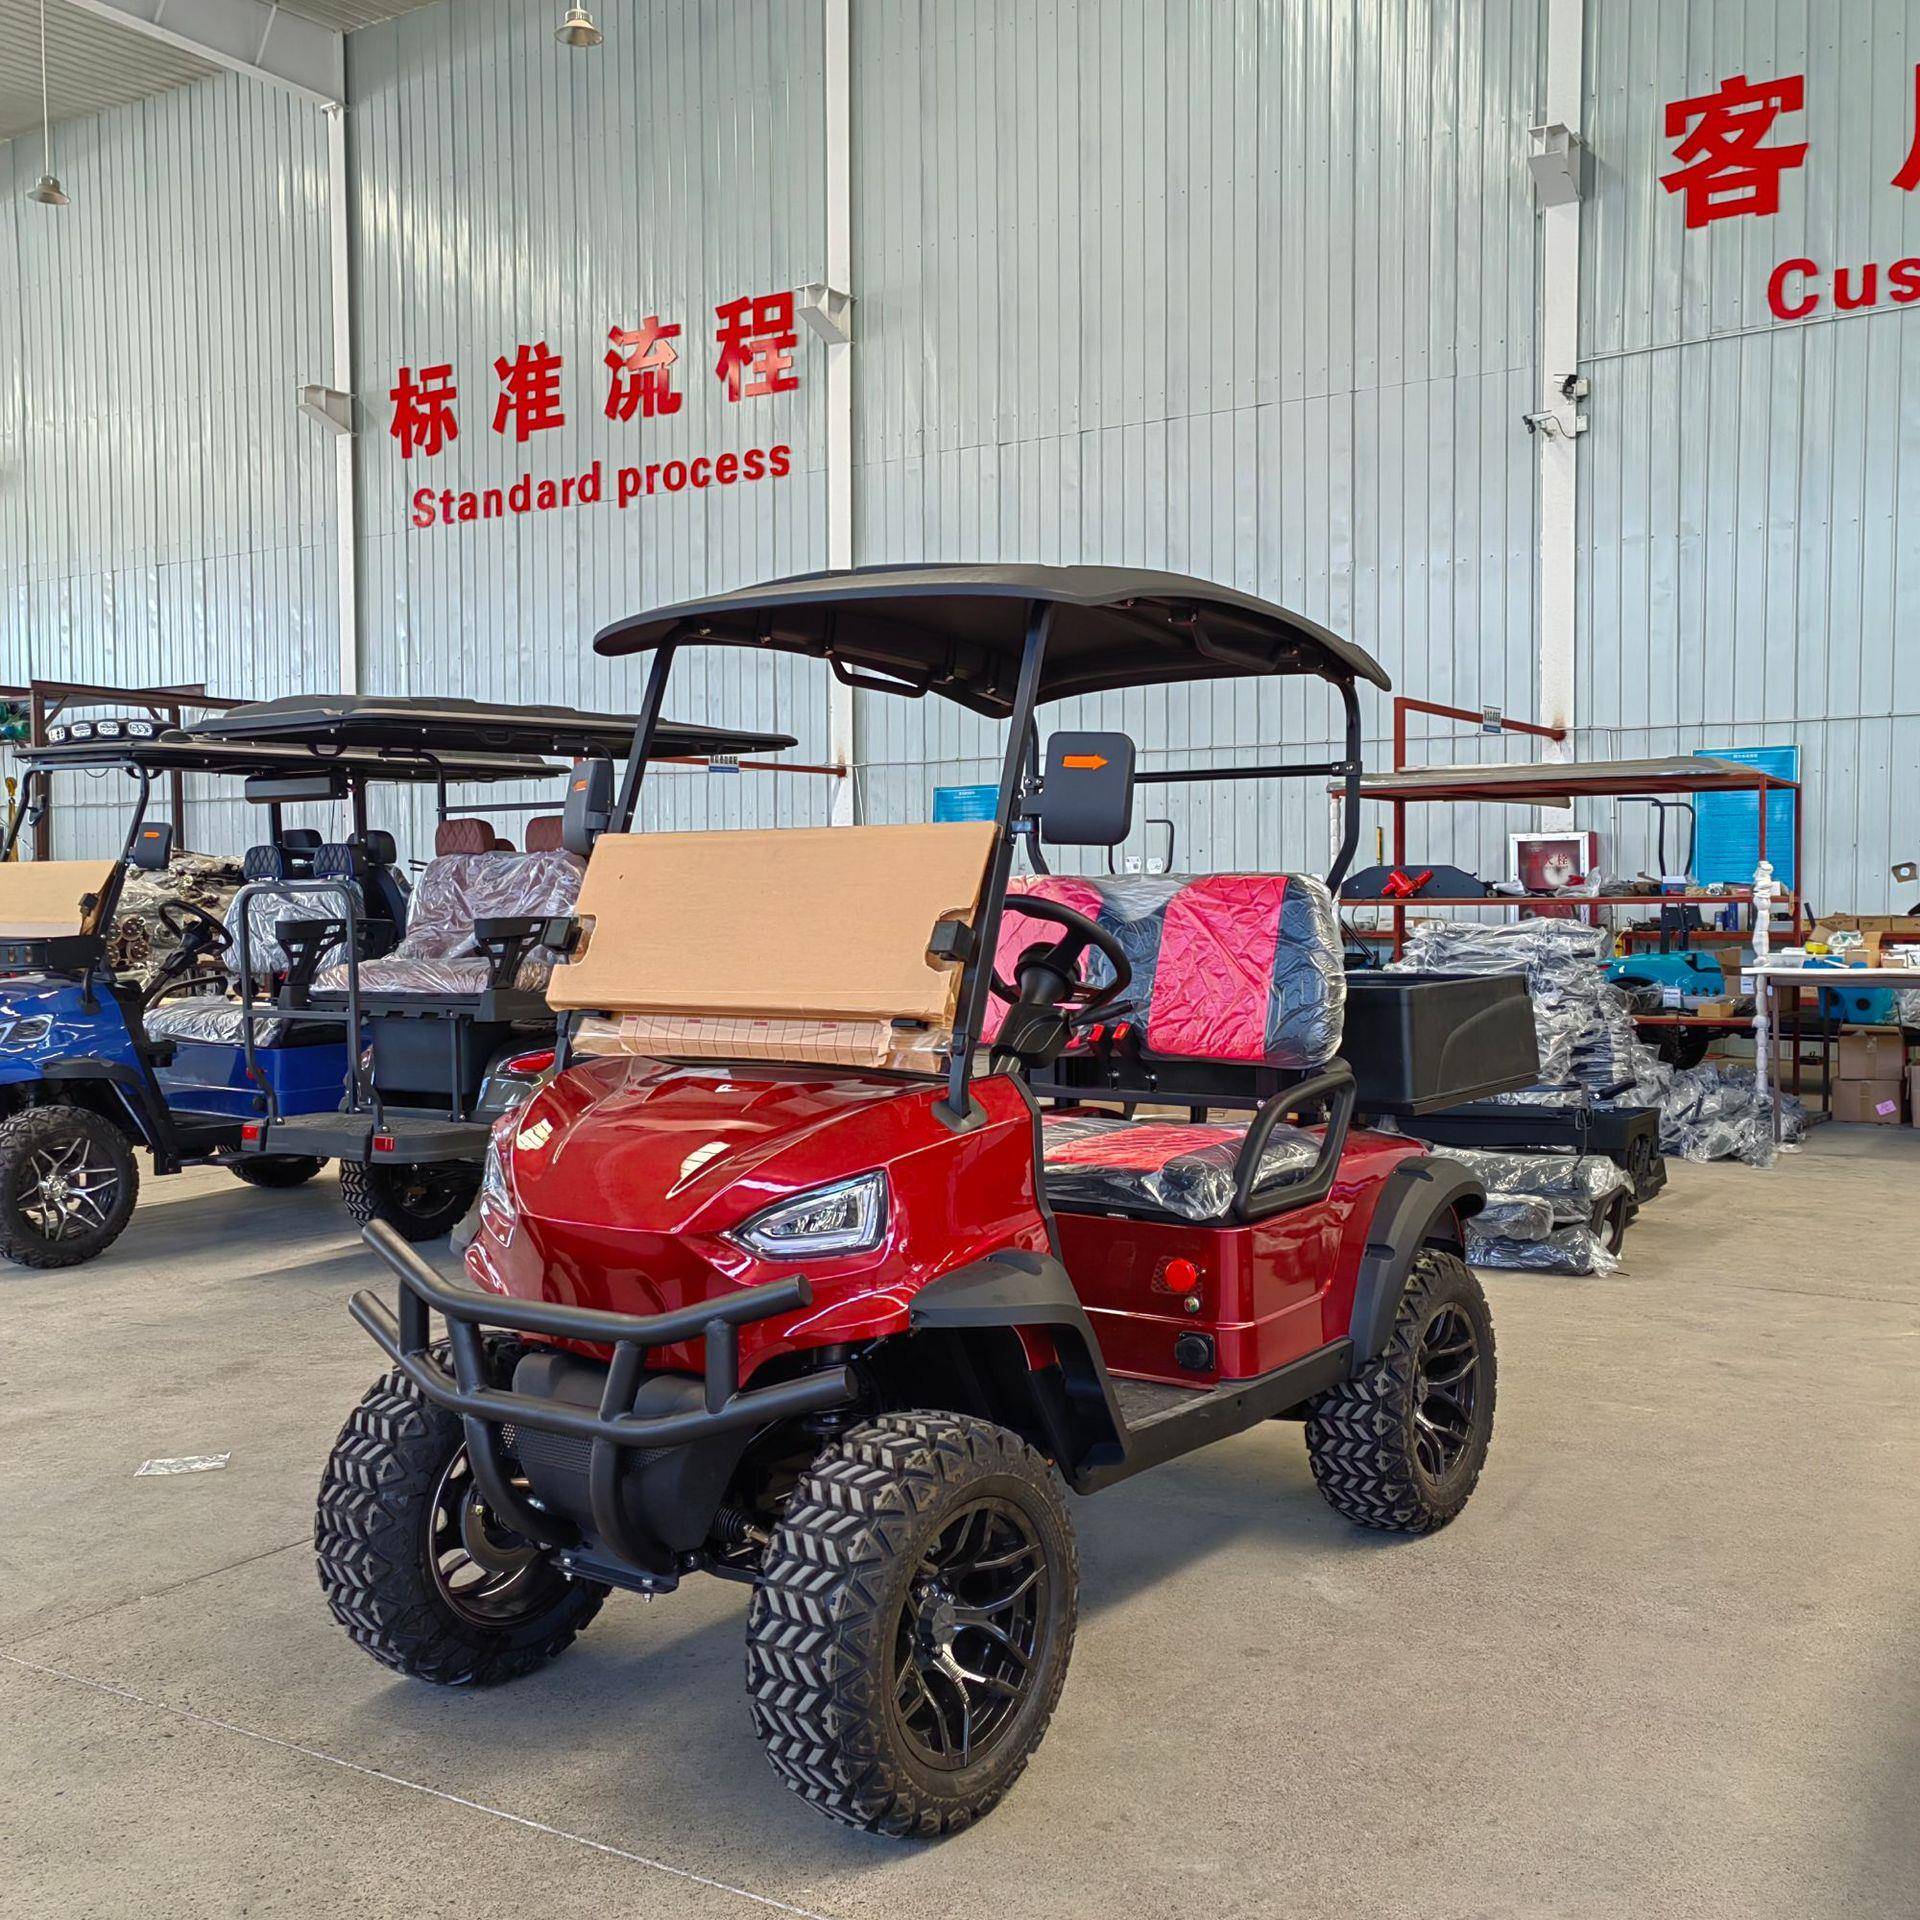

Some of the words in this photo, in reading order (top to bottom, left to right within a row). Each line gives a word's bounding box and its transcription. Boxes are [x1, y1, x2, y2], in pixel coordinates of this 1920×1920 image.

[1767, 258, 1920, 320] Cus
[389, 292, 799, 459] 标准流程
[413, 460, 602, 528] Standard
[618, 445, 791, 508] process
